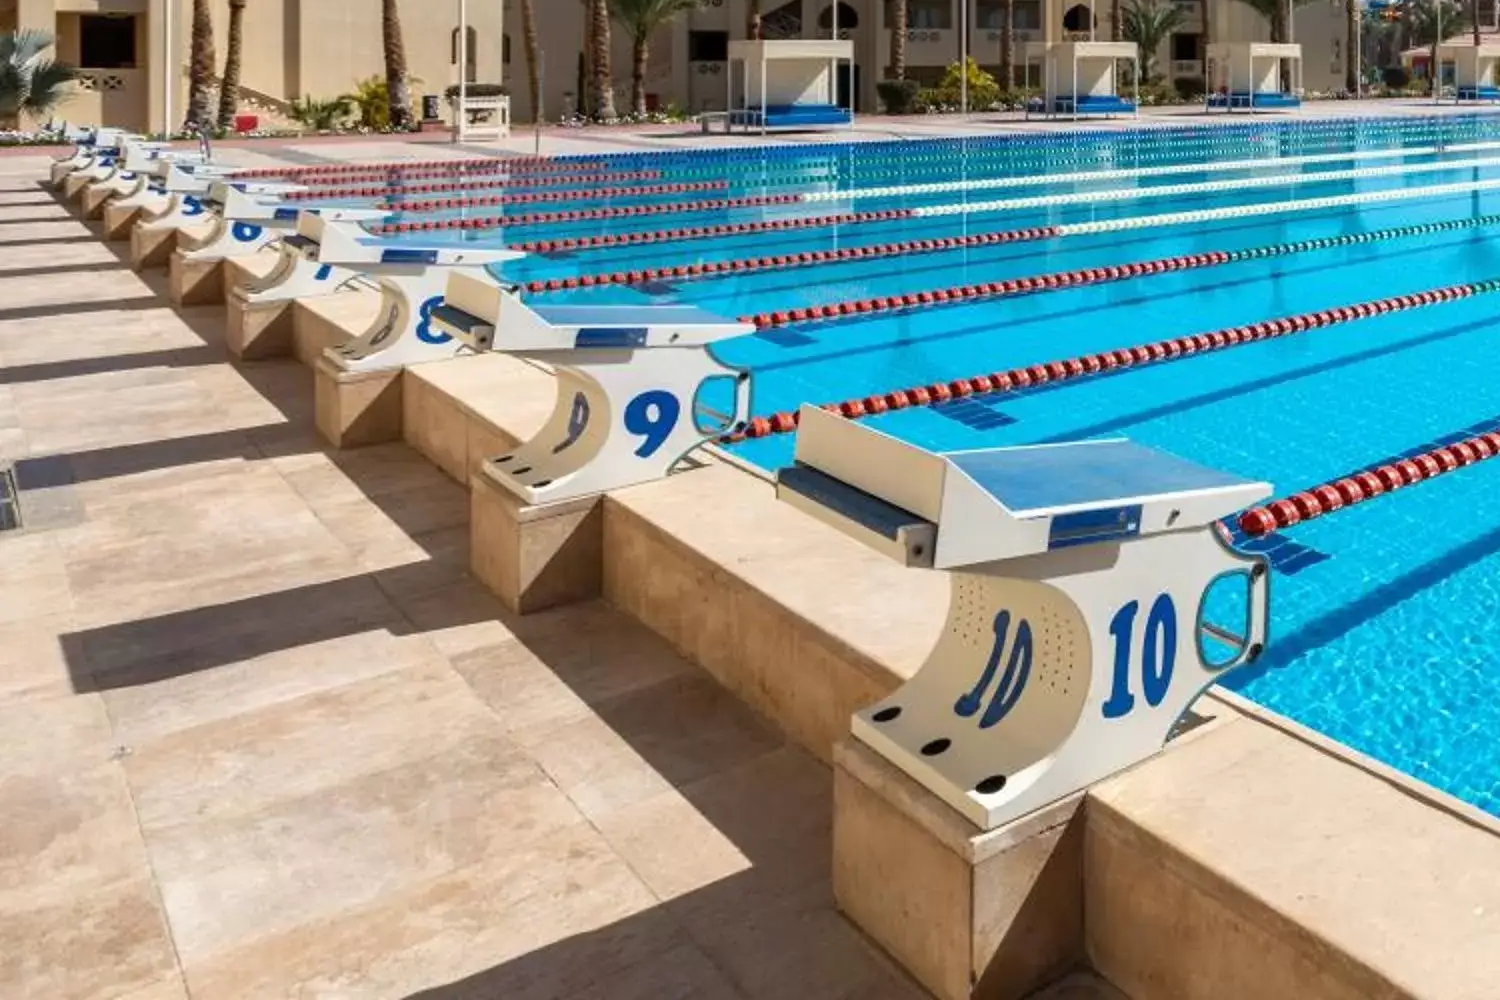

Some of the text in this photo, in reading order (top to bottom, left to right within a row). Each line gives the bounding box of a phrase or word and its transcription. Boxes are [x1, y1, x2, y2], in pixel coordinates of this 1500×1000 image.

[416, 295, 453, 344] 8
[552, 391, 590, 455] 9
[623, 389, 680, 459] 9
[954, 608, 1033, 729] 10
[1101, 592, 1177, 719] 10
